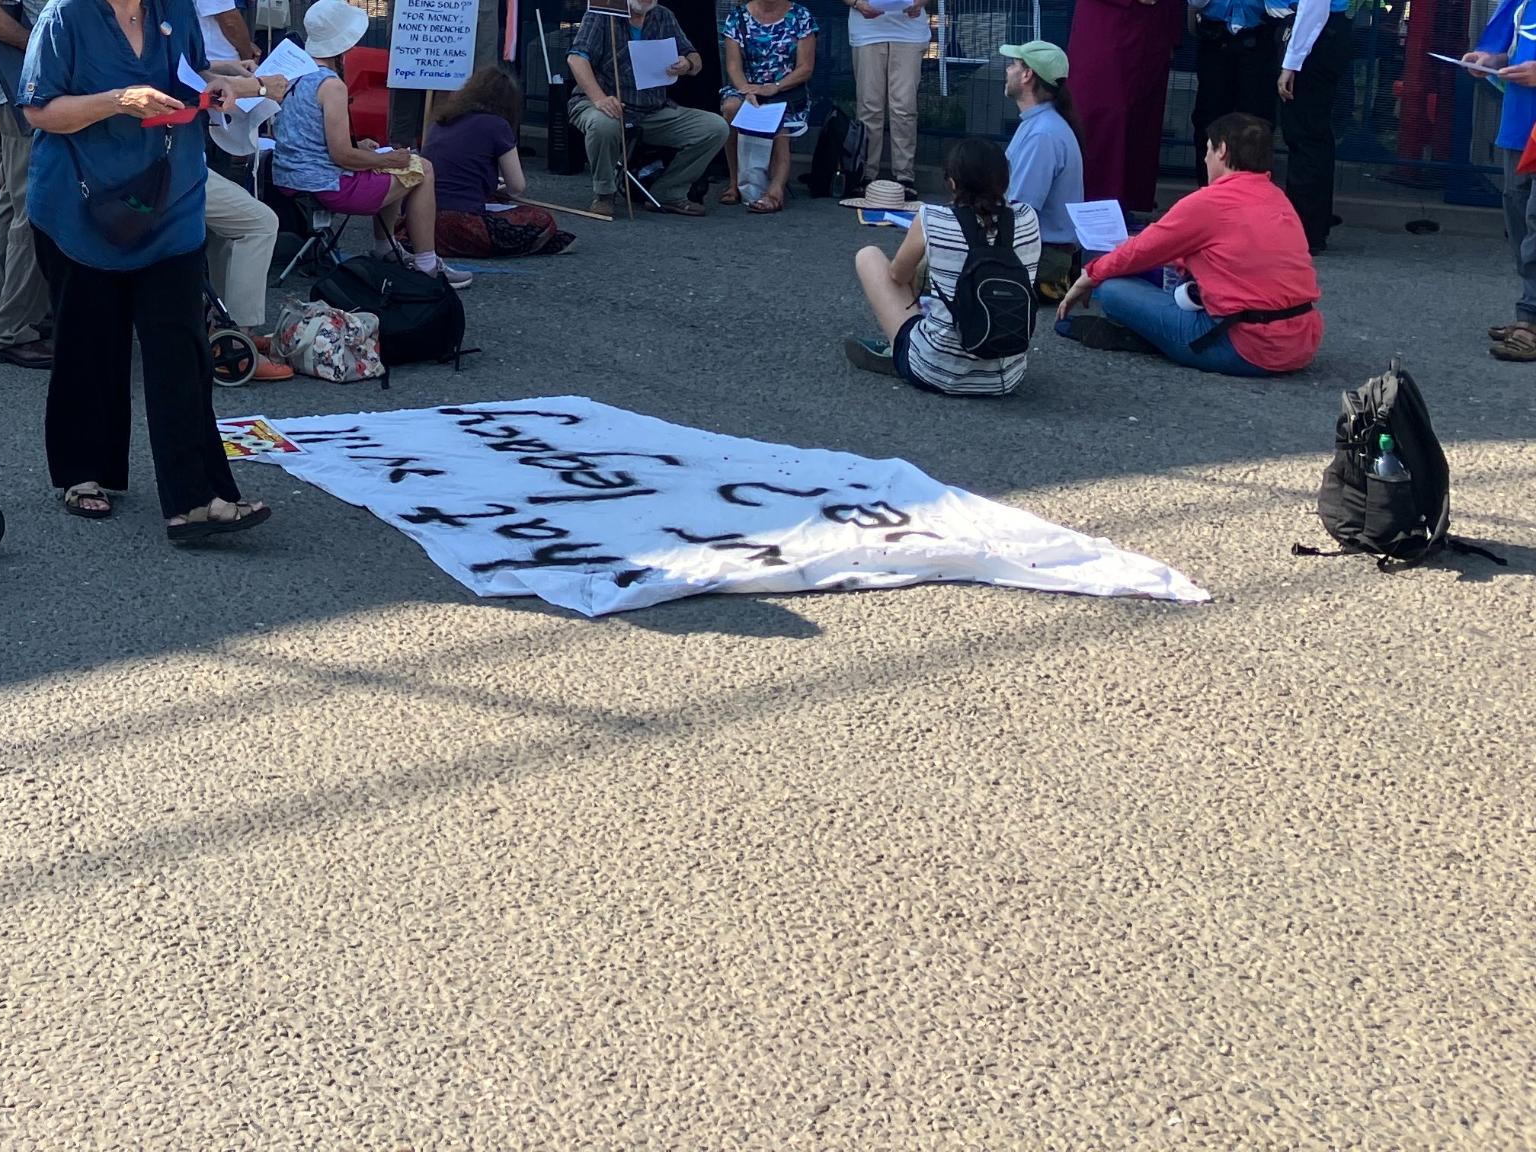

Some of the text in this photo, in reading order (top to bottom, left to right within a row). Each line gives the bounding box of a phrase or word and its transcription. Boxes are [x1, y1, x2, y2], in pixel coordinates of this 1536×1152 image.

[408, 0, 436, 8] BEING
[398, 23, 471, 34] MONEY DRENCHED
[410, 34, 419, 42] IN
[425, 48, 440, 56] THE
[443, 48, 467, 58] ARMS
[395, 68, 416, 80] Pope
[419, 69, 452, 78] Francis
[438, 406, 684, 506] legacy
